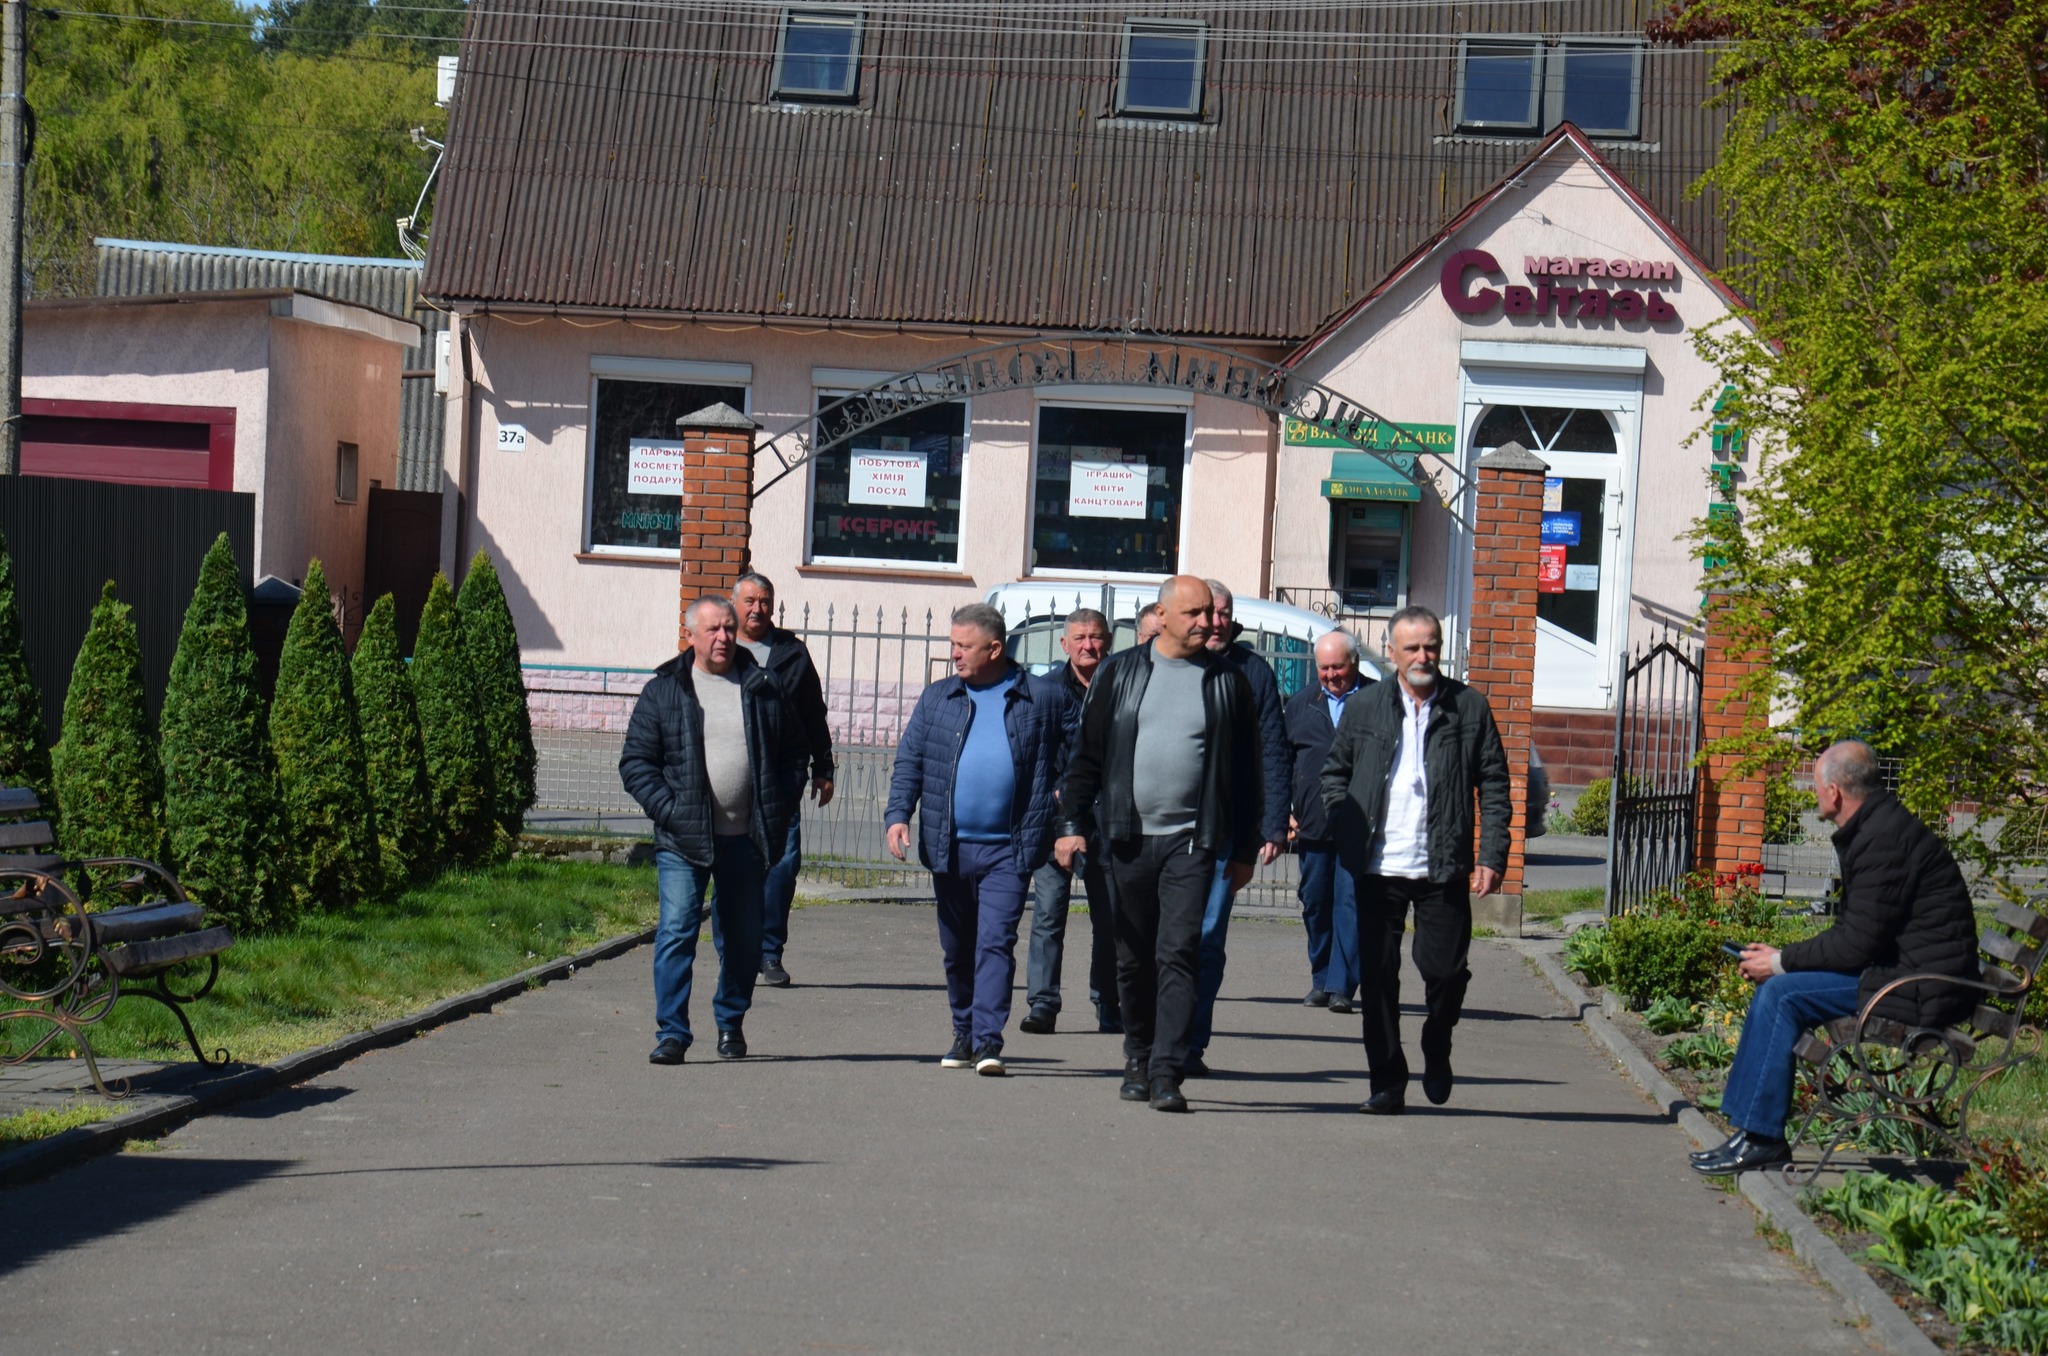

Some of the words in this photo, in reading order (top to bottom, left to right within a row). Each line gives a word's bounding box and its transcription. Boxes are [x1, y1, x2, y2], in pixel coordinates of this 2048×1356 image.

[1524, 256, 1674, 280] магазин
[1440, 249, 1676, 321] Світязь
[499, 430, 525, 444] 37а
[1310, 426, 1337, 439] ВА
[858, 458, 920, 469] ПОБУТОВА
[872, 473, 905, 482] ХІМІЯ
[1086, 471, 1132, 479] ІГРАШКИ
[867, 486, 908, 496] ПОСУД
[1094, 485, 1125, 493] КВІТИ
[1344, 486, 1409, 498] ОЩАДБАНК
[1074, 498, 1143, 507] КАНЦТОВАРИ
[1700, 385, 1742, 608] АПТЕК
[838, 516, 938, 535] КСЕРОКС
